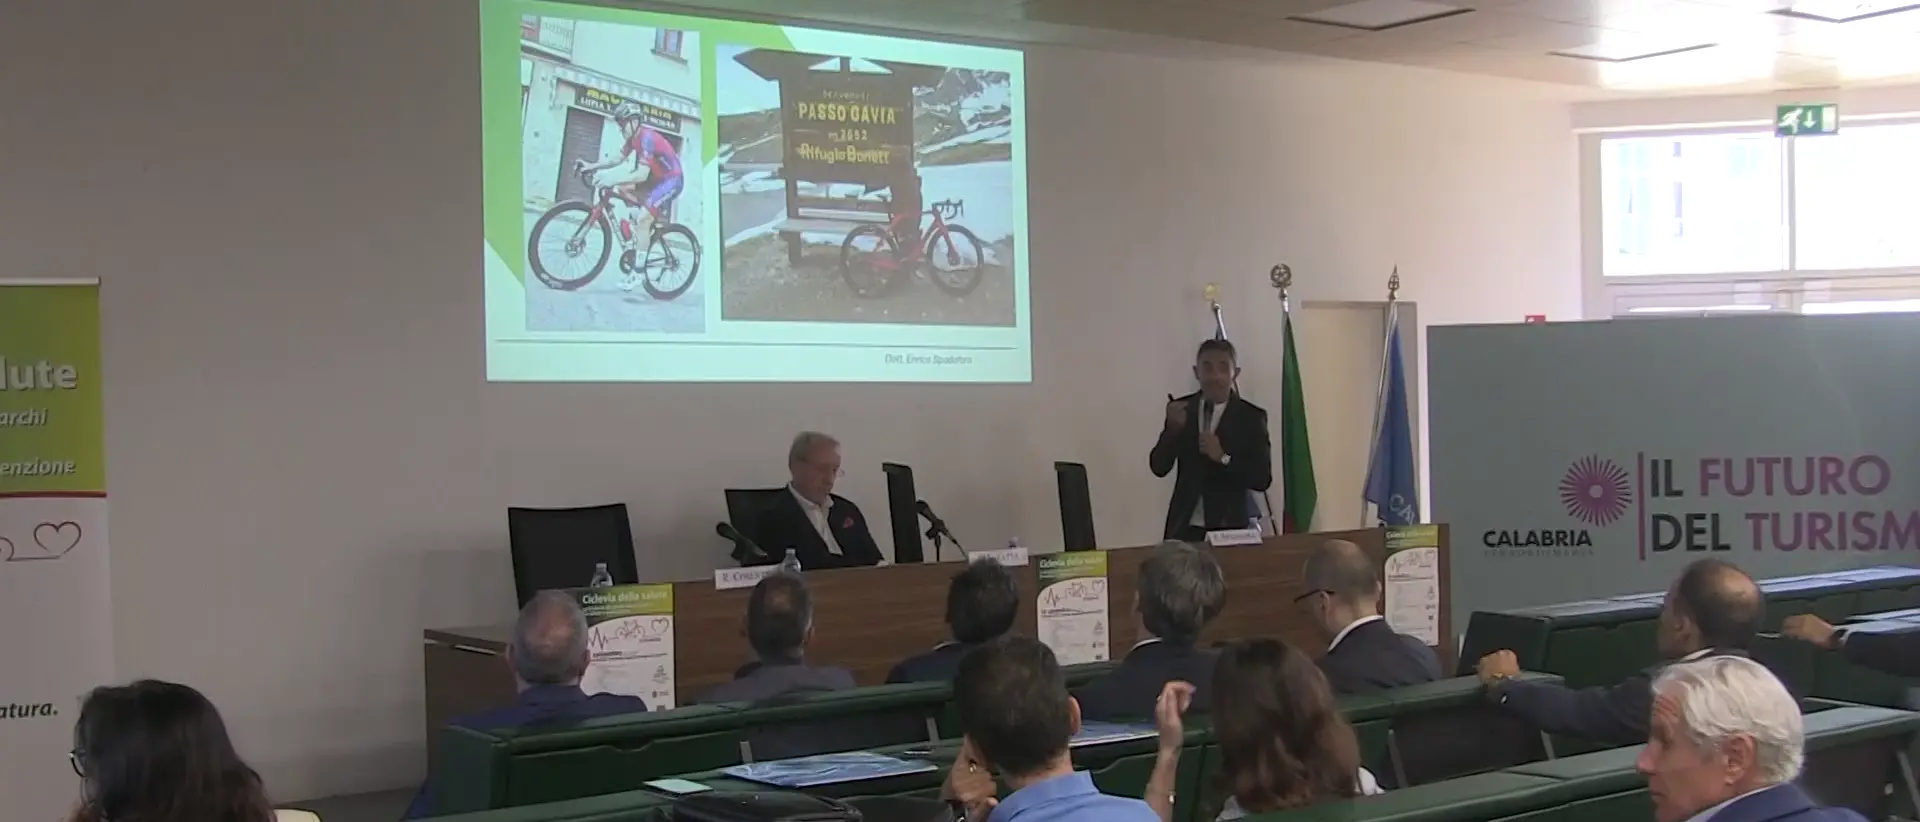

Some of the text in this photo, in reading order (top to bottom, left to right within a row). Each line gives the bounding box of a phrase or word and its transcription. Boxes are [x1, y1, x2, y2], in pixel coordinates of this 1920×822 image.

[798, 102, 896, 124] PASSO GAVIA
[1651, 455, 1891, 497] IL FUTURO
[1483, 528, 1593, 548] CALABRIA
[1651, 510, 1920, 552] DEL TURISM
